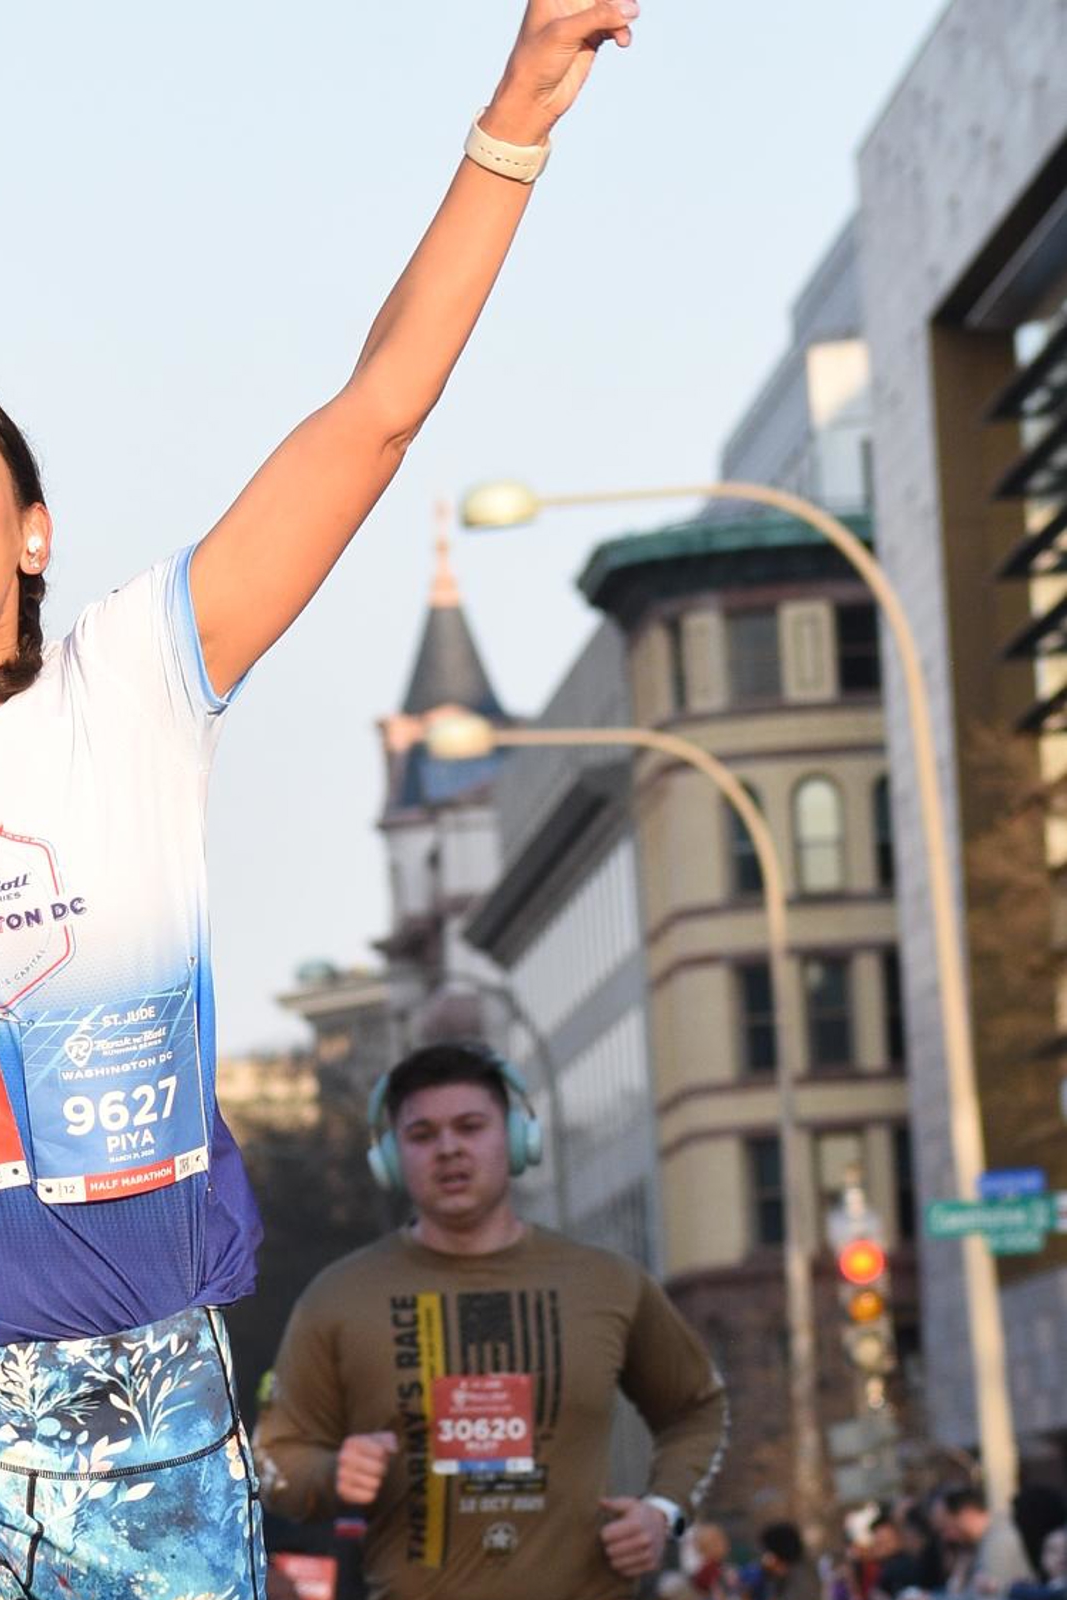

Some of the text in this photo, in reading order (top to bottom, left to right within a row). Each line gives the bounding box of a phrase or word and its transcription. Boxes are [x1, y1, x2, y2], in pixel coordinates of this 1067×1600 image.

[50, 897, 88, 921] DC
[13, 948, 47, 981] CAPITAL
[101, 1005, 157, 1028] ST. JUDE
[60, 1050, 174, 1082] WASHINGTON DC
[62, 1074, 178, 1136] 9627
[105, 1128, 156, 1154] PIYA
[62, 1184, 76, 1195] 12
[89, 1165, 173, 1193] HALF MARATHON
[390, 1294, 422, 1370] RACE
[397, 1382, 427, 1496] ARMY'S
[437, 1416, 527, 1443] 30620
